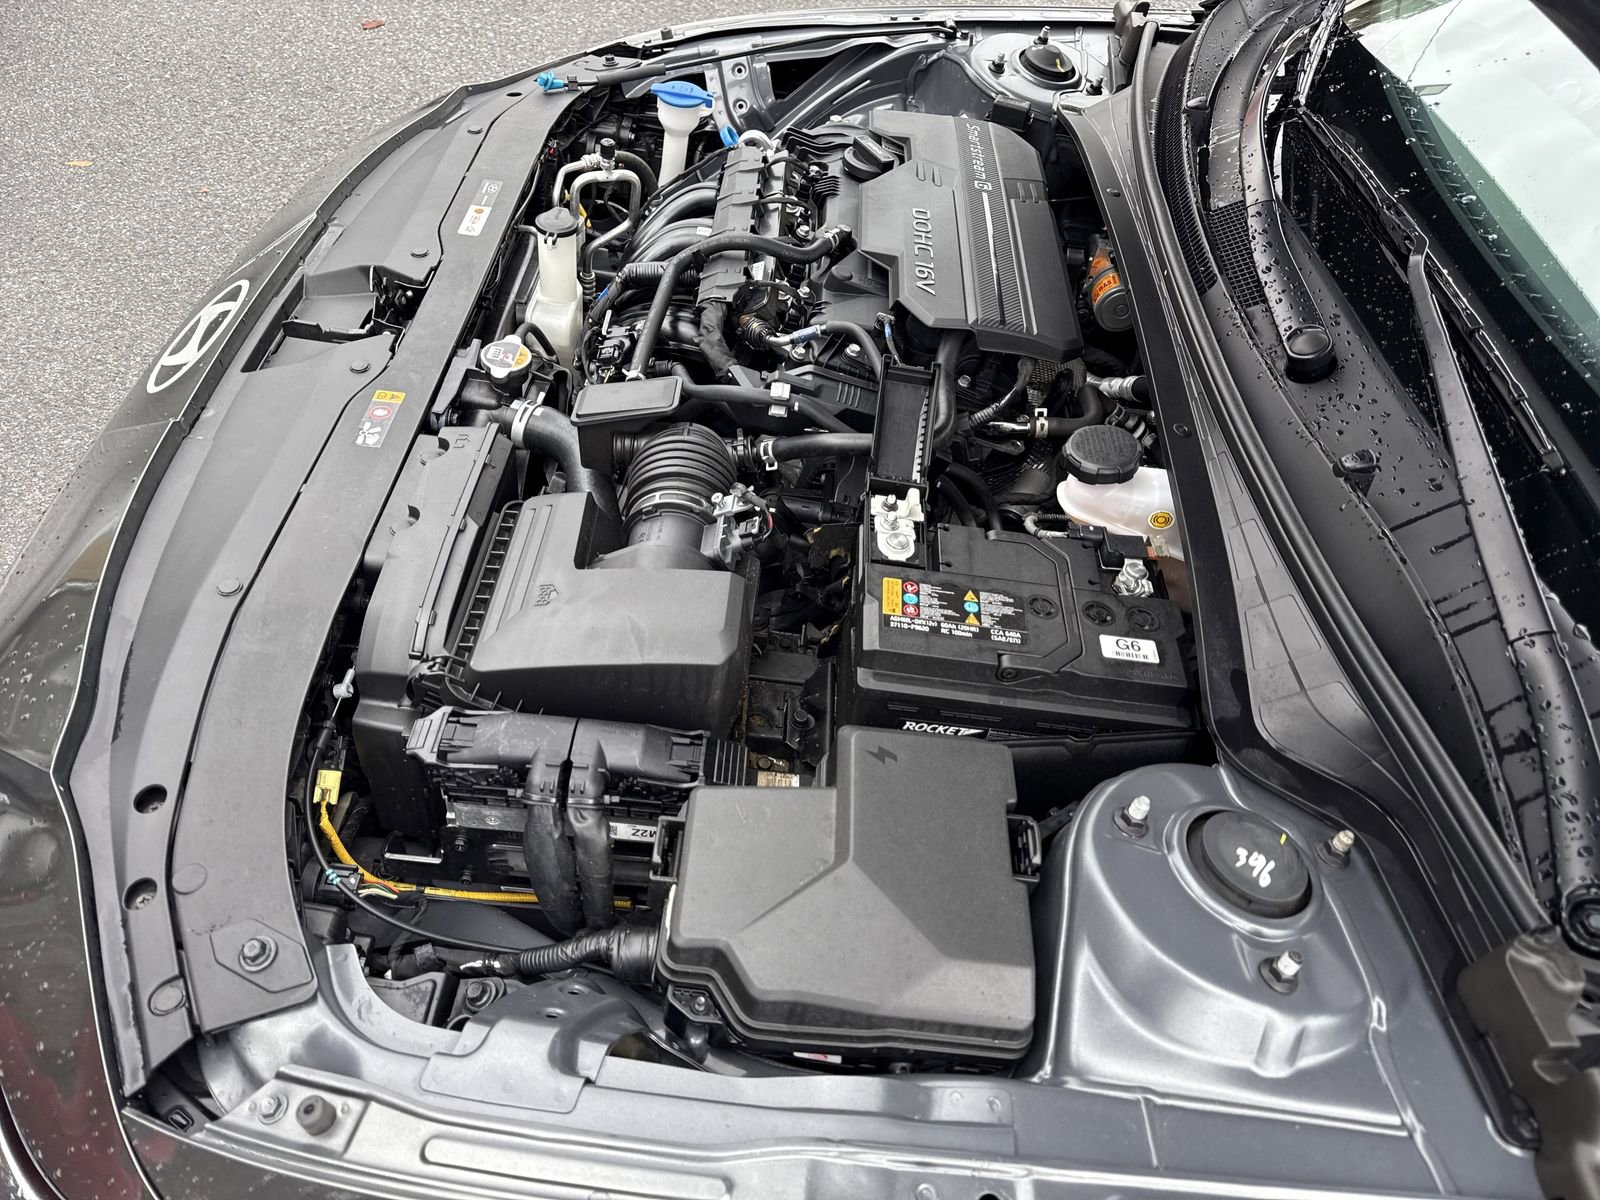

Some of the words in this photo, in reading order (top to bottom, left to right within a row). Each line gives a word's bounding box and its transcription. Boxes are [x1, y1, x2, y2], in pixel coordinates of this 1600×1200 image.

[966, 123, 986, 180] Smartstream
[912, 207, 934, 258] DOHC
[914, 261, 937, 296] 16V
[1115, 639, 1141, 652] G6
[902, 721, 969, 736] ROCKET
